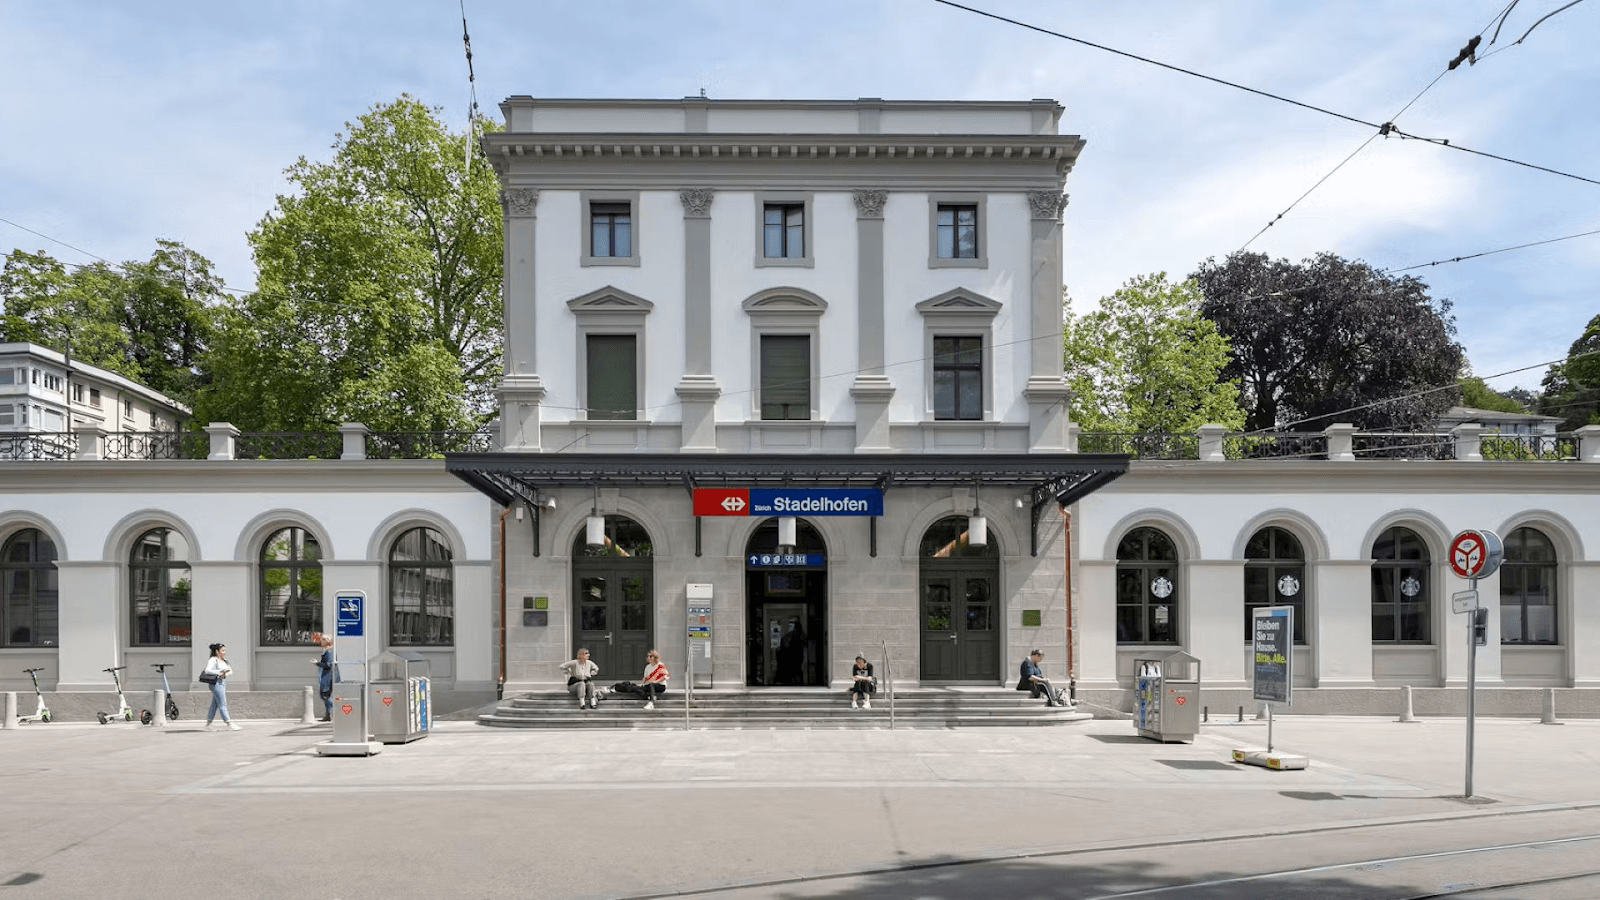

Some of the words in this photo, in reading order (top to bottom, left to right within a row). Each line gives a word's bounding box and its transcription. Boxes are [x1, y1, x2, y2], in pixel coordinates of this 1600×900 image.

[774, 497, 868, 511] Stadelhofen
[1257, 620, 1279, 630] Bleiben
[1257, 631, 1266, 640] Sie
[1256, 642, 1277, 652] Hause.
